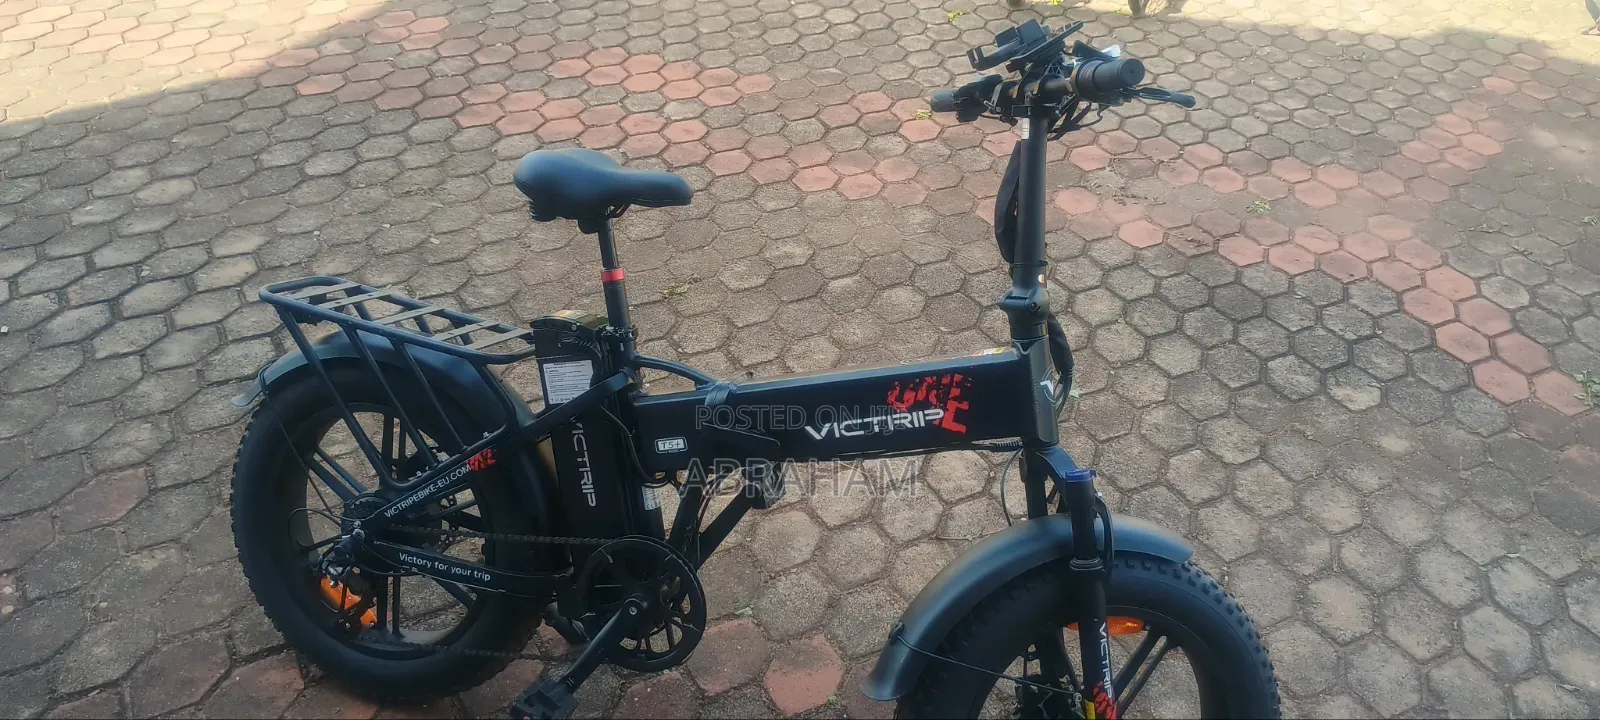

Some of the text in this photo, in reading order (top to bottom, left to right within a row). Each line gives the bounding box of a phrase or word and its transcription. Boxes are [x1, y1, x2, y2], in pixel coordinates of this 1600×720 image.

[660, 439, 682, 450] T5+
[384, 463, 472, 519] VICTRIPEBIKE-EU.COM
[398, 552, 491, 582] Victory for your trip
